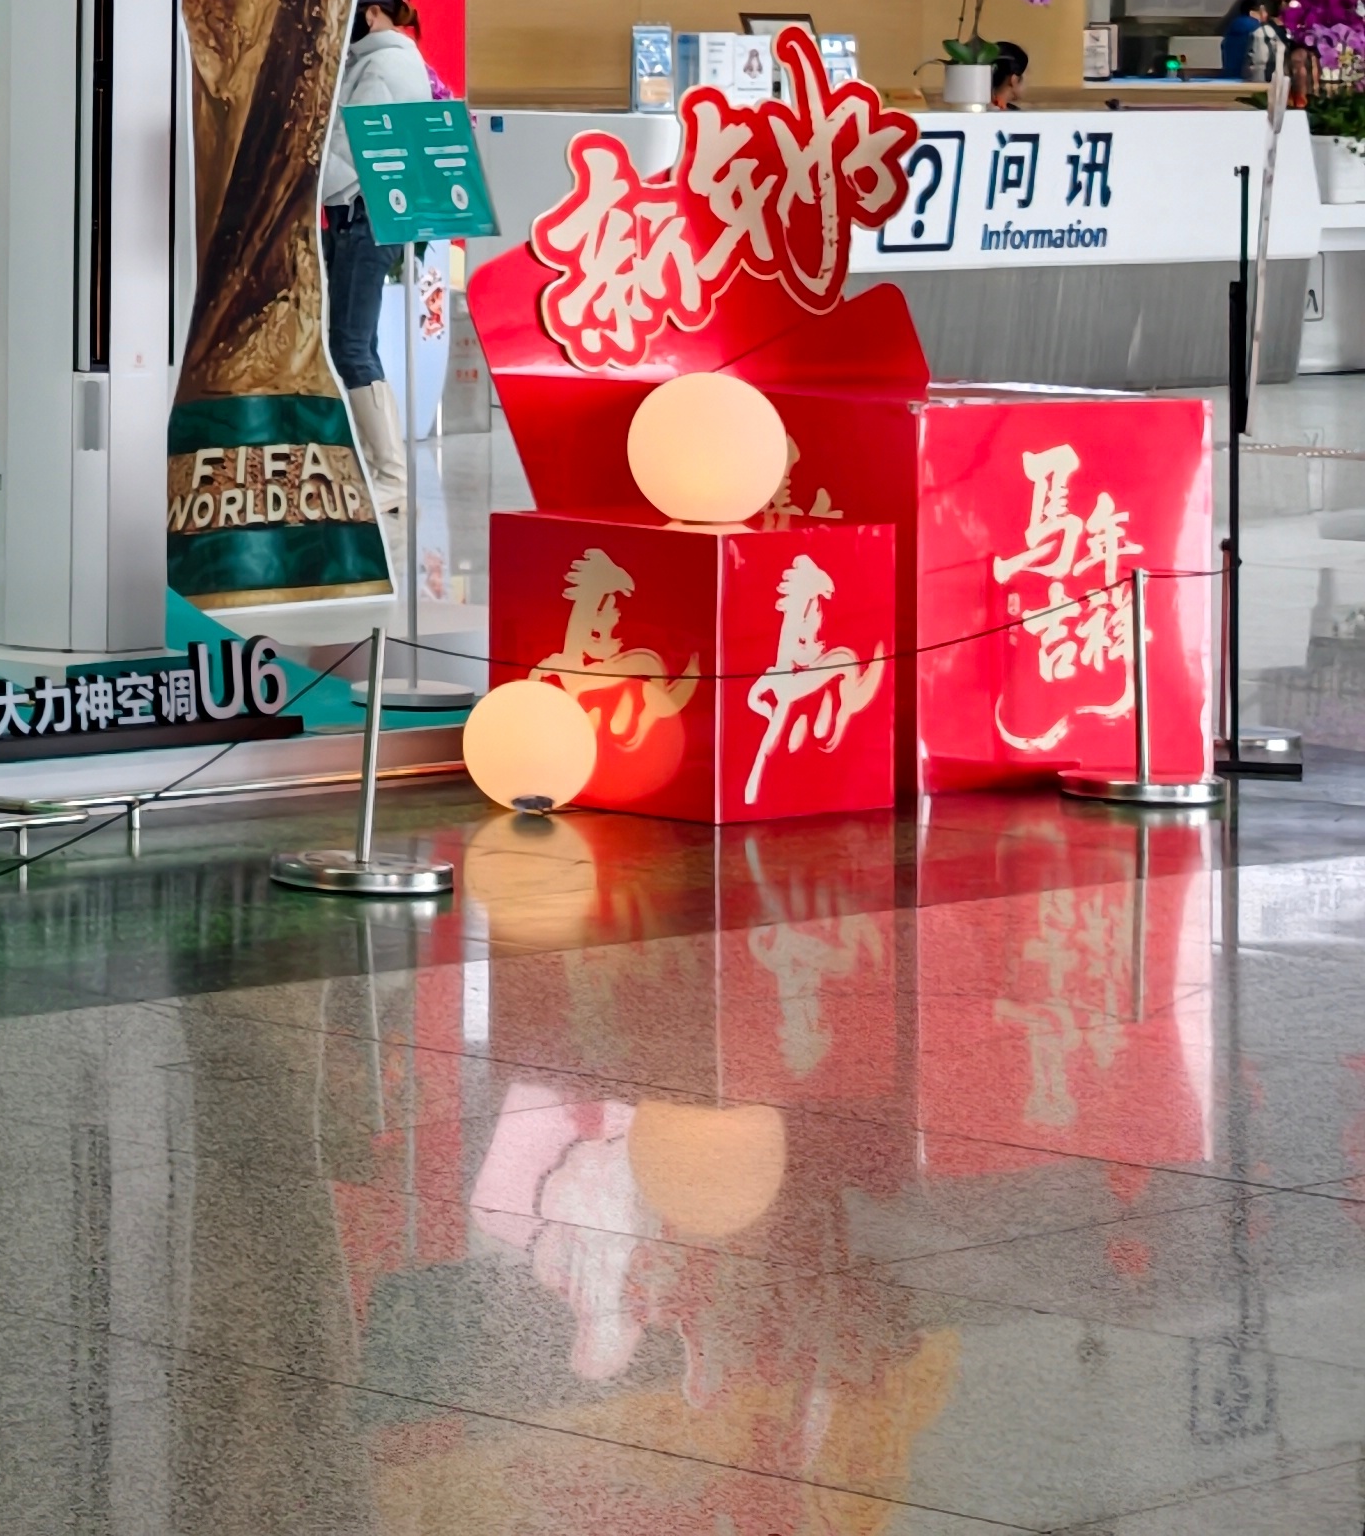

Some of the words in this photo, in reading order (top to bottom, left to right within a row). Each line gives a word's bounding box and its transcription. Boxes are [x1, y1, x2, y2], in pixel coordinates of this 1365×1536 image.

[985, 130, 1114, 209] 问讯
[980, 220, 1108, 251] Information
[191, 442, 332, 490] FIFA
[167, 484, 288, 530] WORLD
[299, 482, 362, 521] CUP
